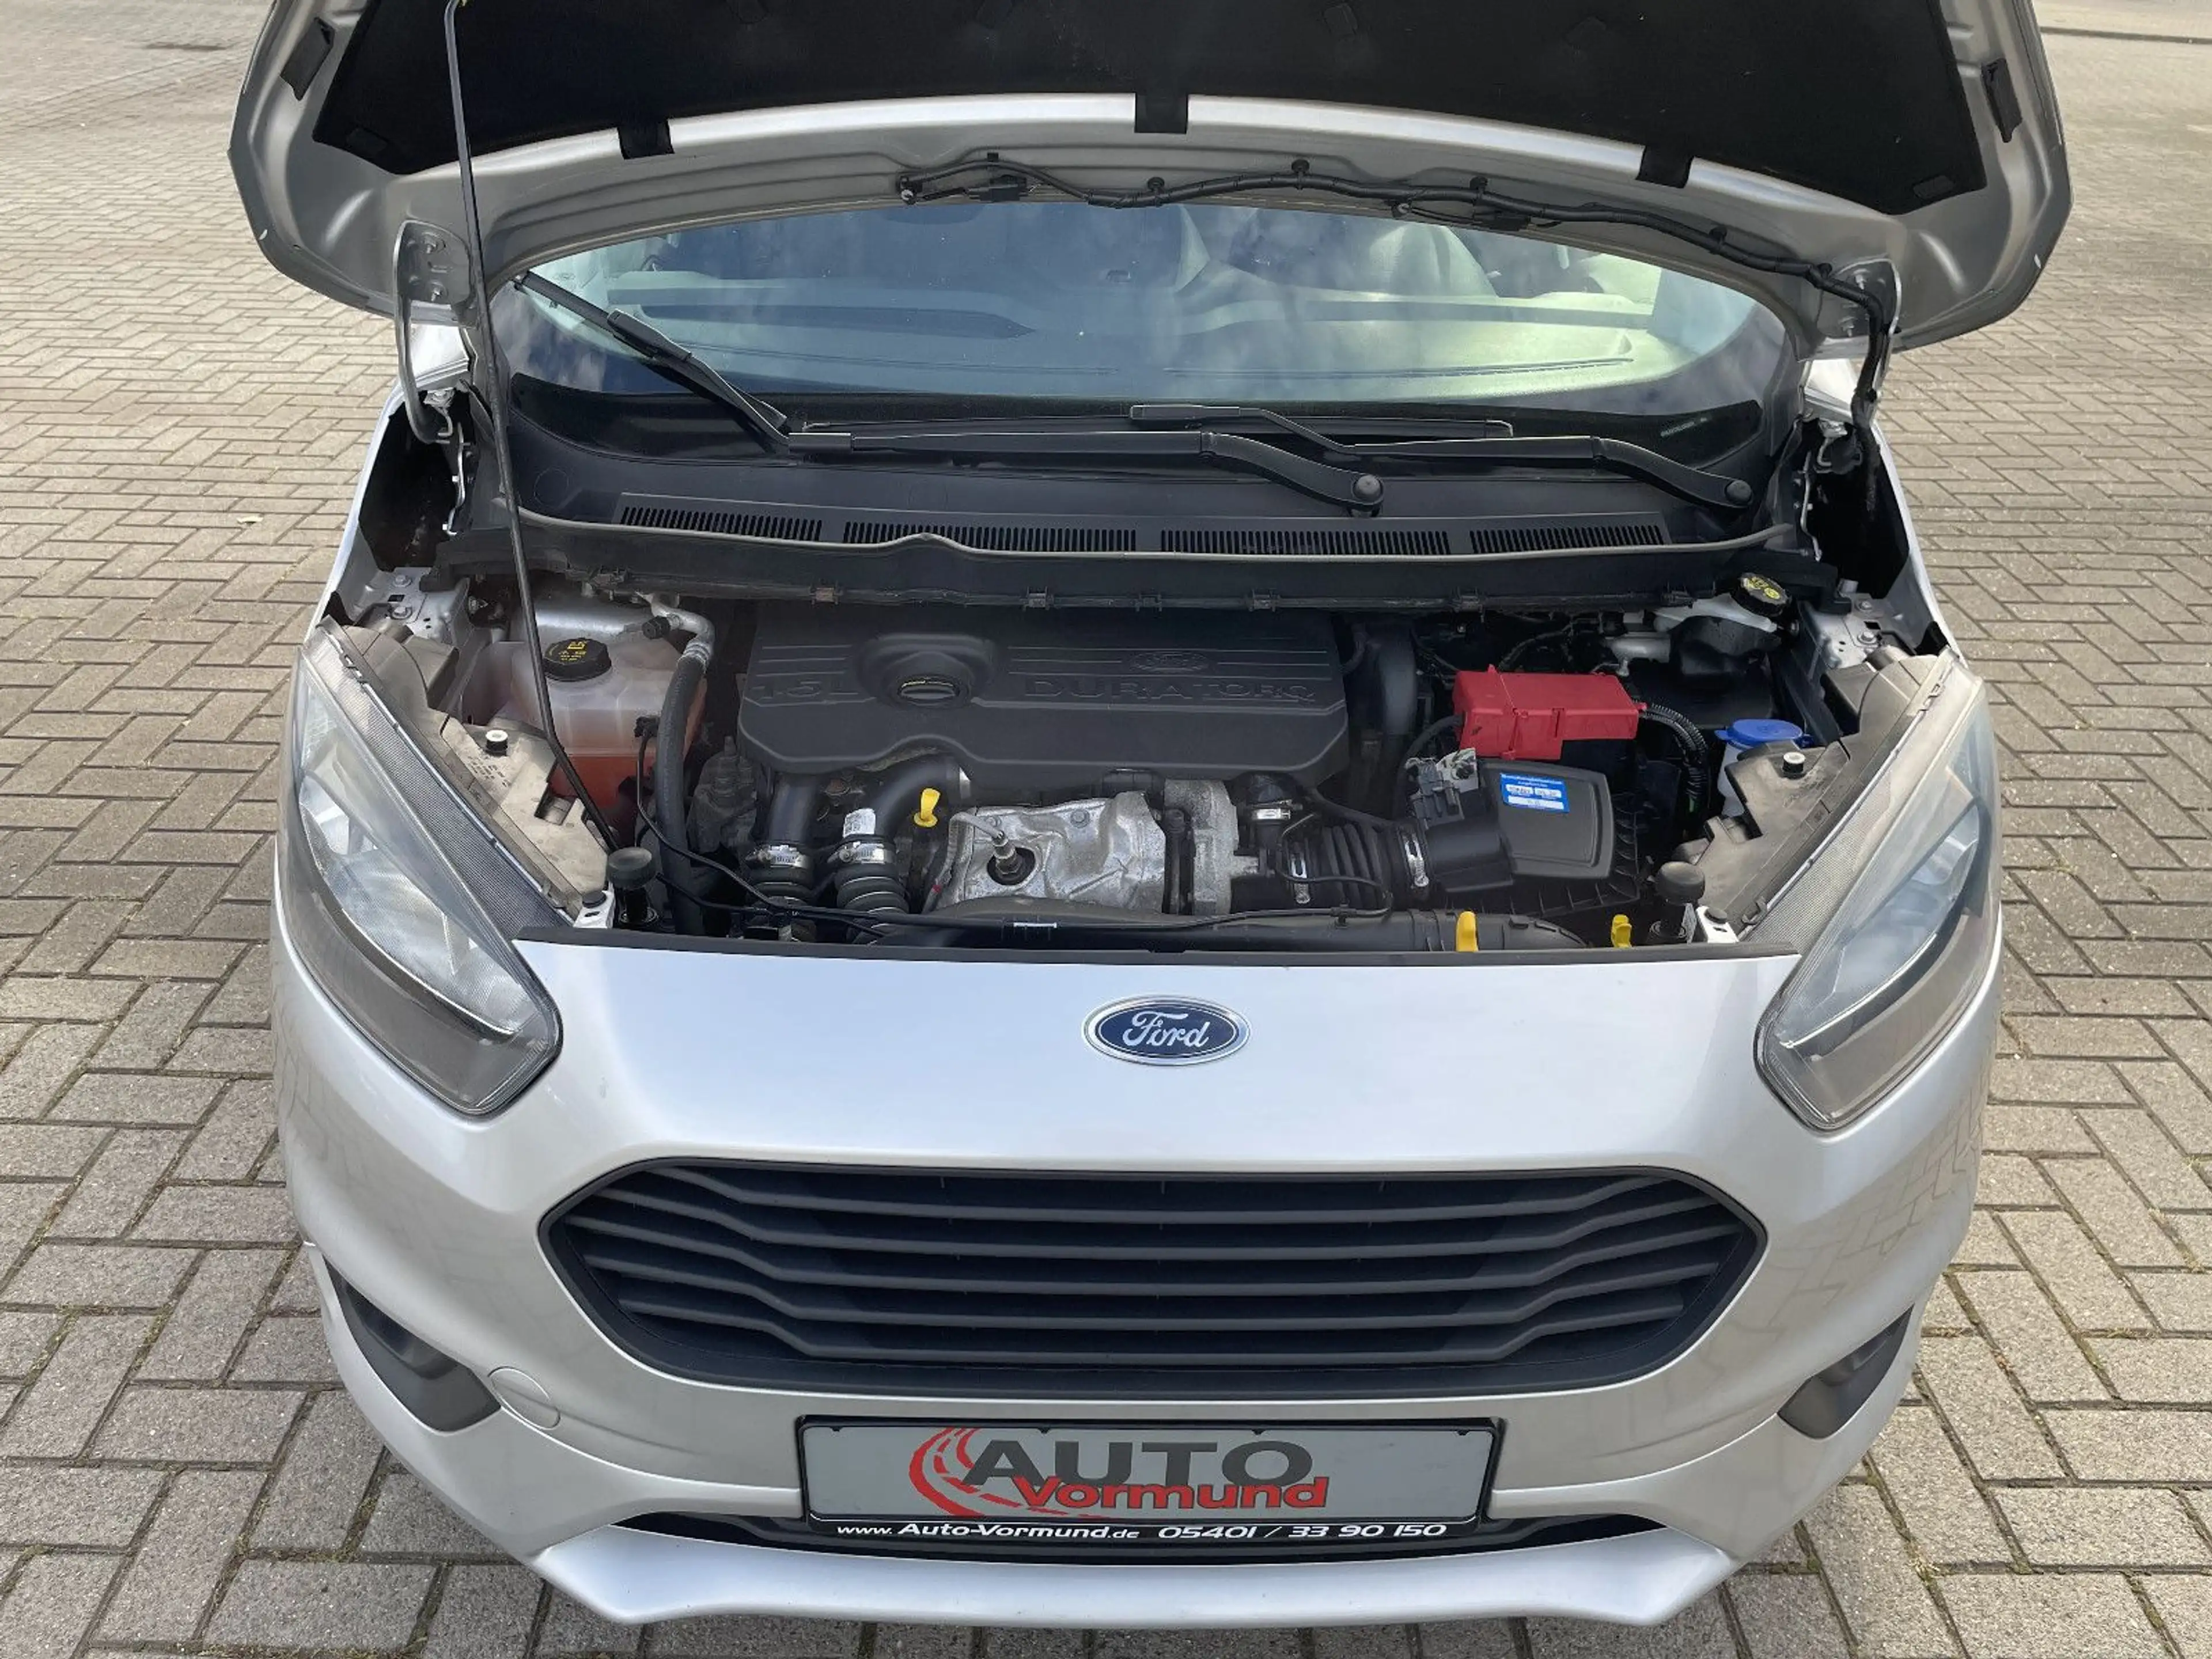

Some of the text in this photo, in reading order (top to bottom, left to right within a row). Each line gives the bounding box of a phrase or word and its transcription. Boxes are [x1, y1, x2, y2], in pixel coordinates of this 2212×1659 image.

[1024, 676, 1316, 702] DURATORQ
[1123, 1010, 1210, 1047] Ford
[961, 1440, 1313, 1488] AUTO
[1011, 1475, 1330, 1509] Vormund
[1158, 1526, 1257, 1539] 05401
[1288, 1526, 1329, 1537] 33
[1338, 1525, 1385, 1537] 90
[1393, 1524, 1447, 1537] 150
